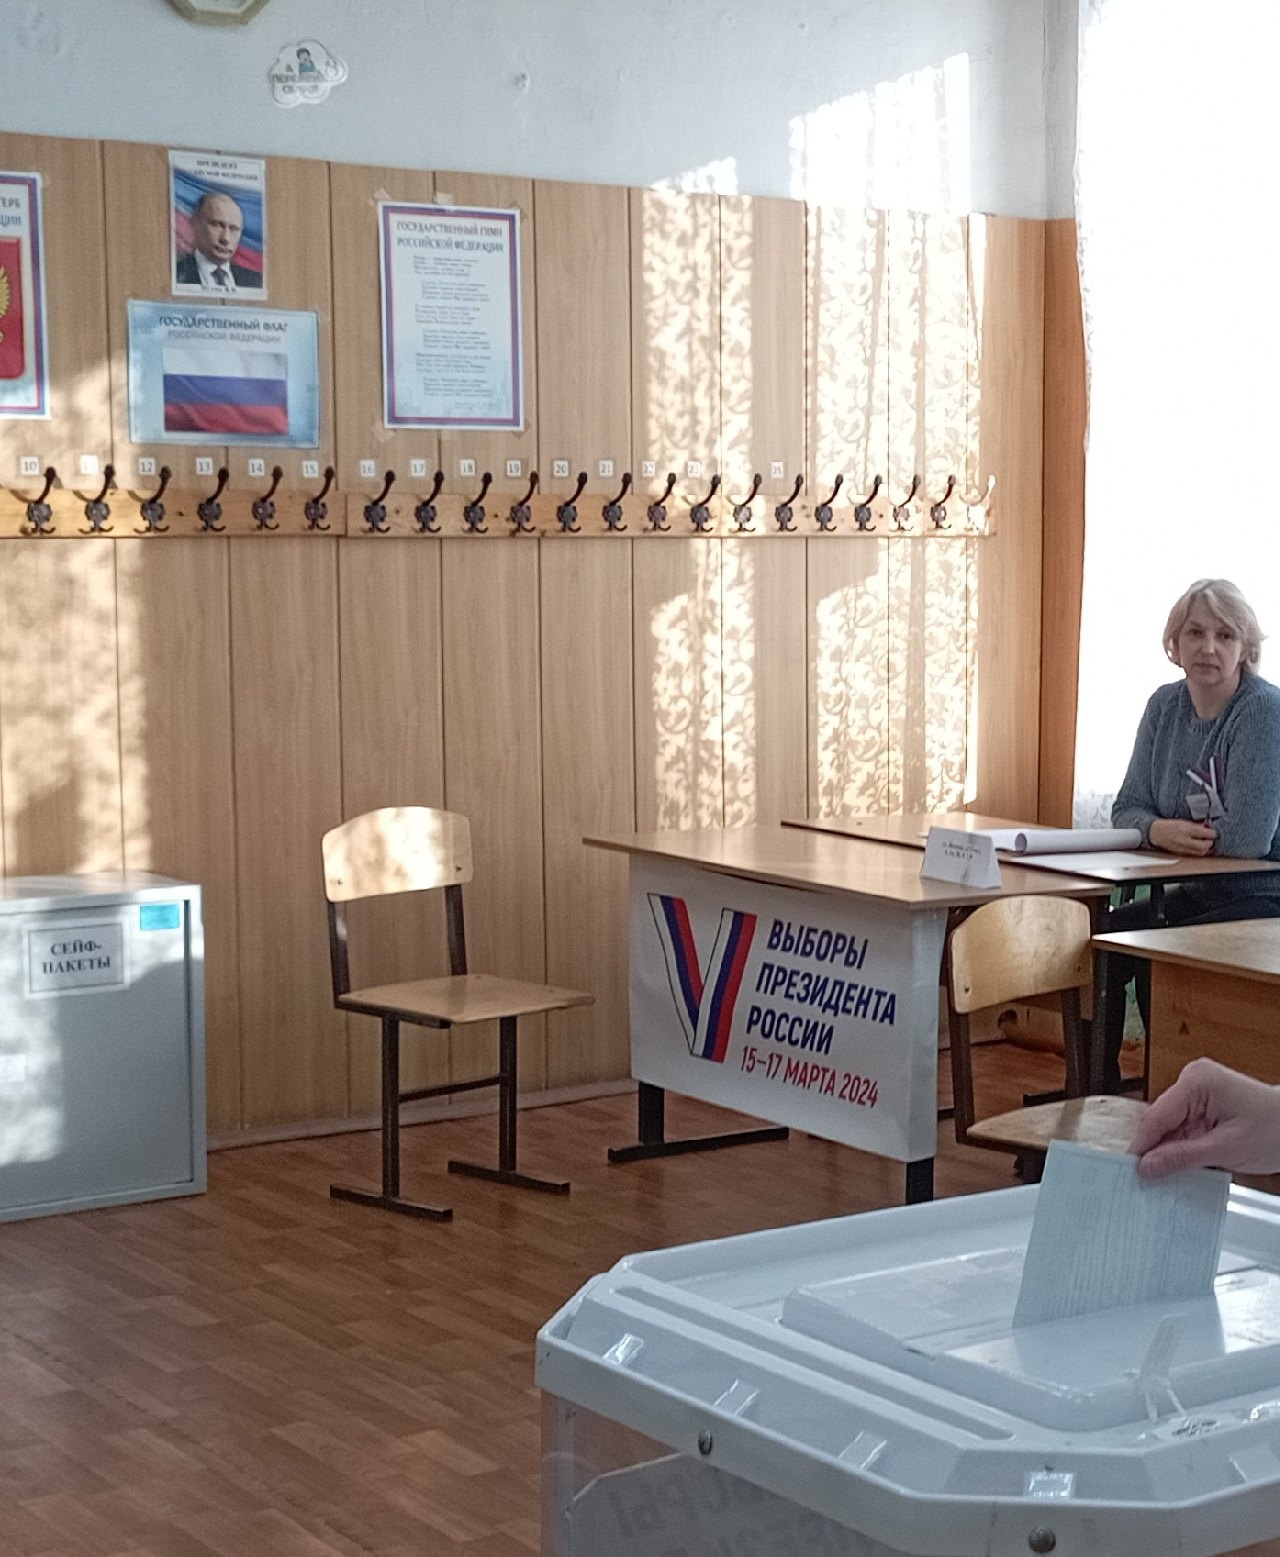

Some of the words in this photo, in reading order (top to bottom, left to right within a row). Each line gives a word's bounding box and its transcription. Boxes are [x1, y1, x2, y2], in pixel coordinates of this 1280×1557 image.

[396, 221, 478, 236] ГОСУДАРСТВЕННЫЙ
[396, 236, 453, 250] РОССИЙСКОЙ
[454, 239, 504, 253] ФЕДЕРАЦИИ
[159, 315, 260, 331] ГОСУДАРСТВЕННЫЙ
[23, 461, 37, 471] 10
[140, 460, 154, 472] 12
[198, 461, 211, 472] 13
[250, 462, 263, 473] 14
[304, 465, 316, 475] 15
[362, 462, 374, 474] 16
[413, 462, 424, 473] 17
[462, 461, 473, 473] 18
[508, 462, 520, 473] 19
[555, 463, 567, 474] 20
[601, 462, 612, 473] 21
[50, 939, 103, 956] СЕЙФ-
[766, 918, 868, 969] ВЫБОРЫ
[42, 956, 111, 974] ПАКЕТЫ
[755, 962, 897, 1026] ПРЕЗИДЕНТА
[746, 1005, 834, 1055] РОССИИ
[741, 1046, 783, 1081] 15–17
[783, 1058, 836, 1096] МАРТА
[838, 1072, 880, 1108] 2024
